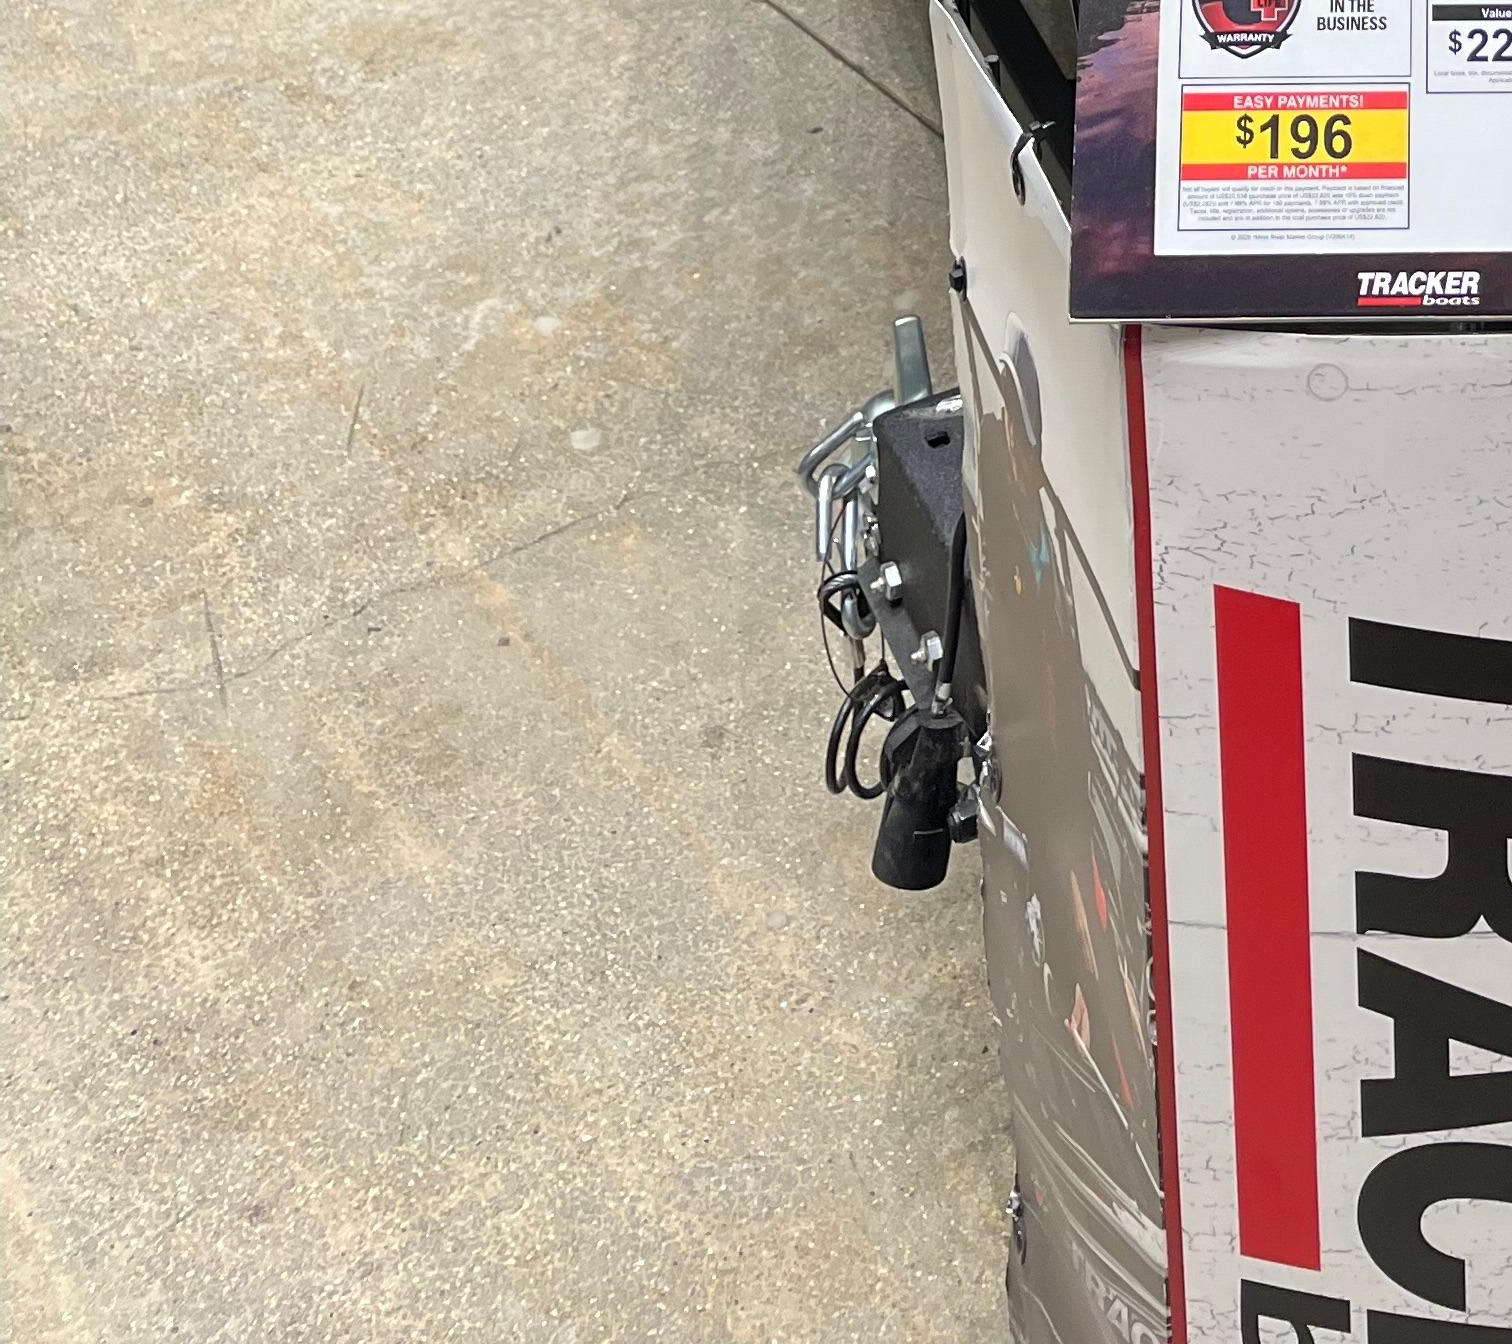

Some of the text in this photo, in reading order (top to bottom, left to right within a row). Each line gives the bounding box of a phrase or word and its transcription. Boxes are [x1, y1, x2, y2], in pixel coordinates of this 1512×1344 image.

[1482, 8, 1512, 18] Value
[1317, 16, 1388, 31] BUSINESS
[1216, 33, 1275, 44] WARRANTY
[1233, 94, 1364, 108] EASY PAYMENTS!
[1236, 113, 1353, 160] $196
[1247, 166, 1279, 179] PER
[1357, 271, 1480, 295] TRACKER
[1422, 294, 1480, 306] boats
